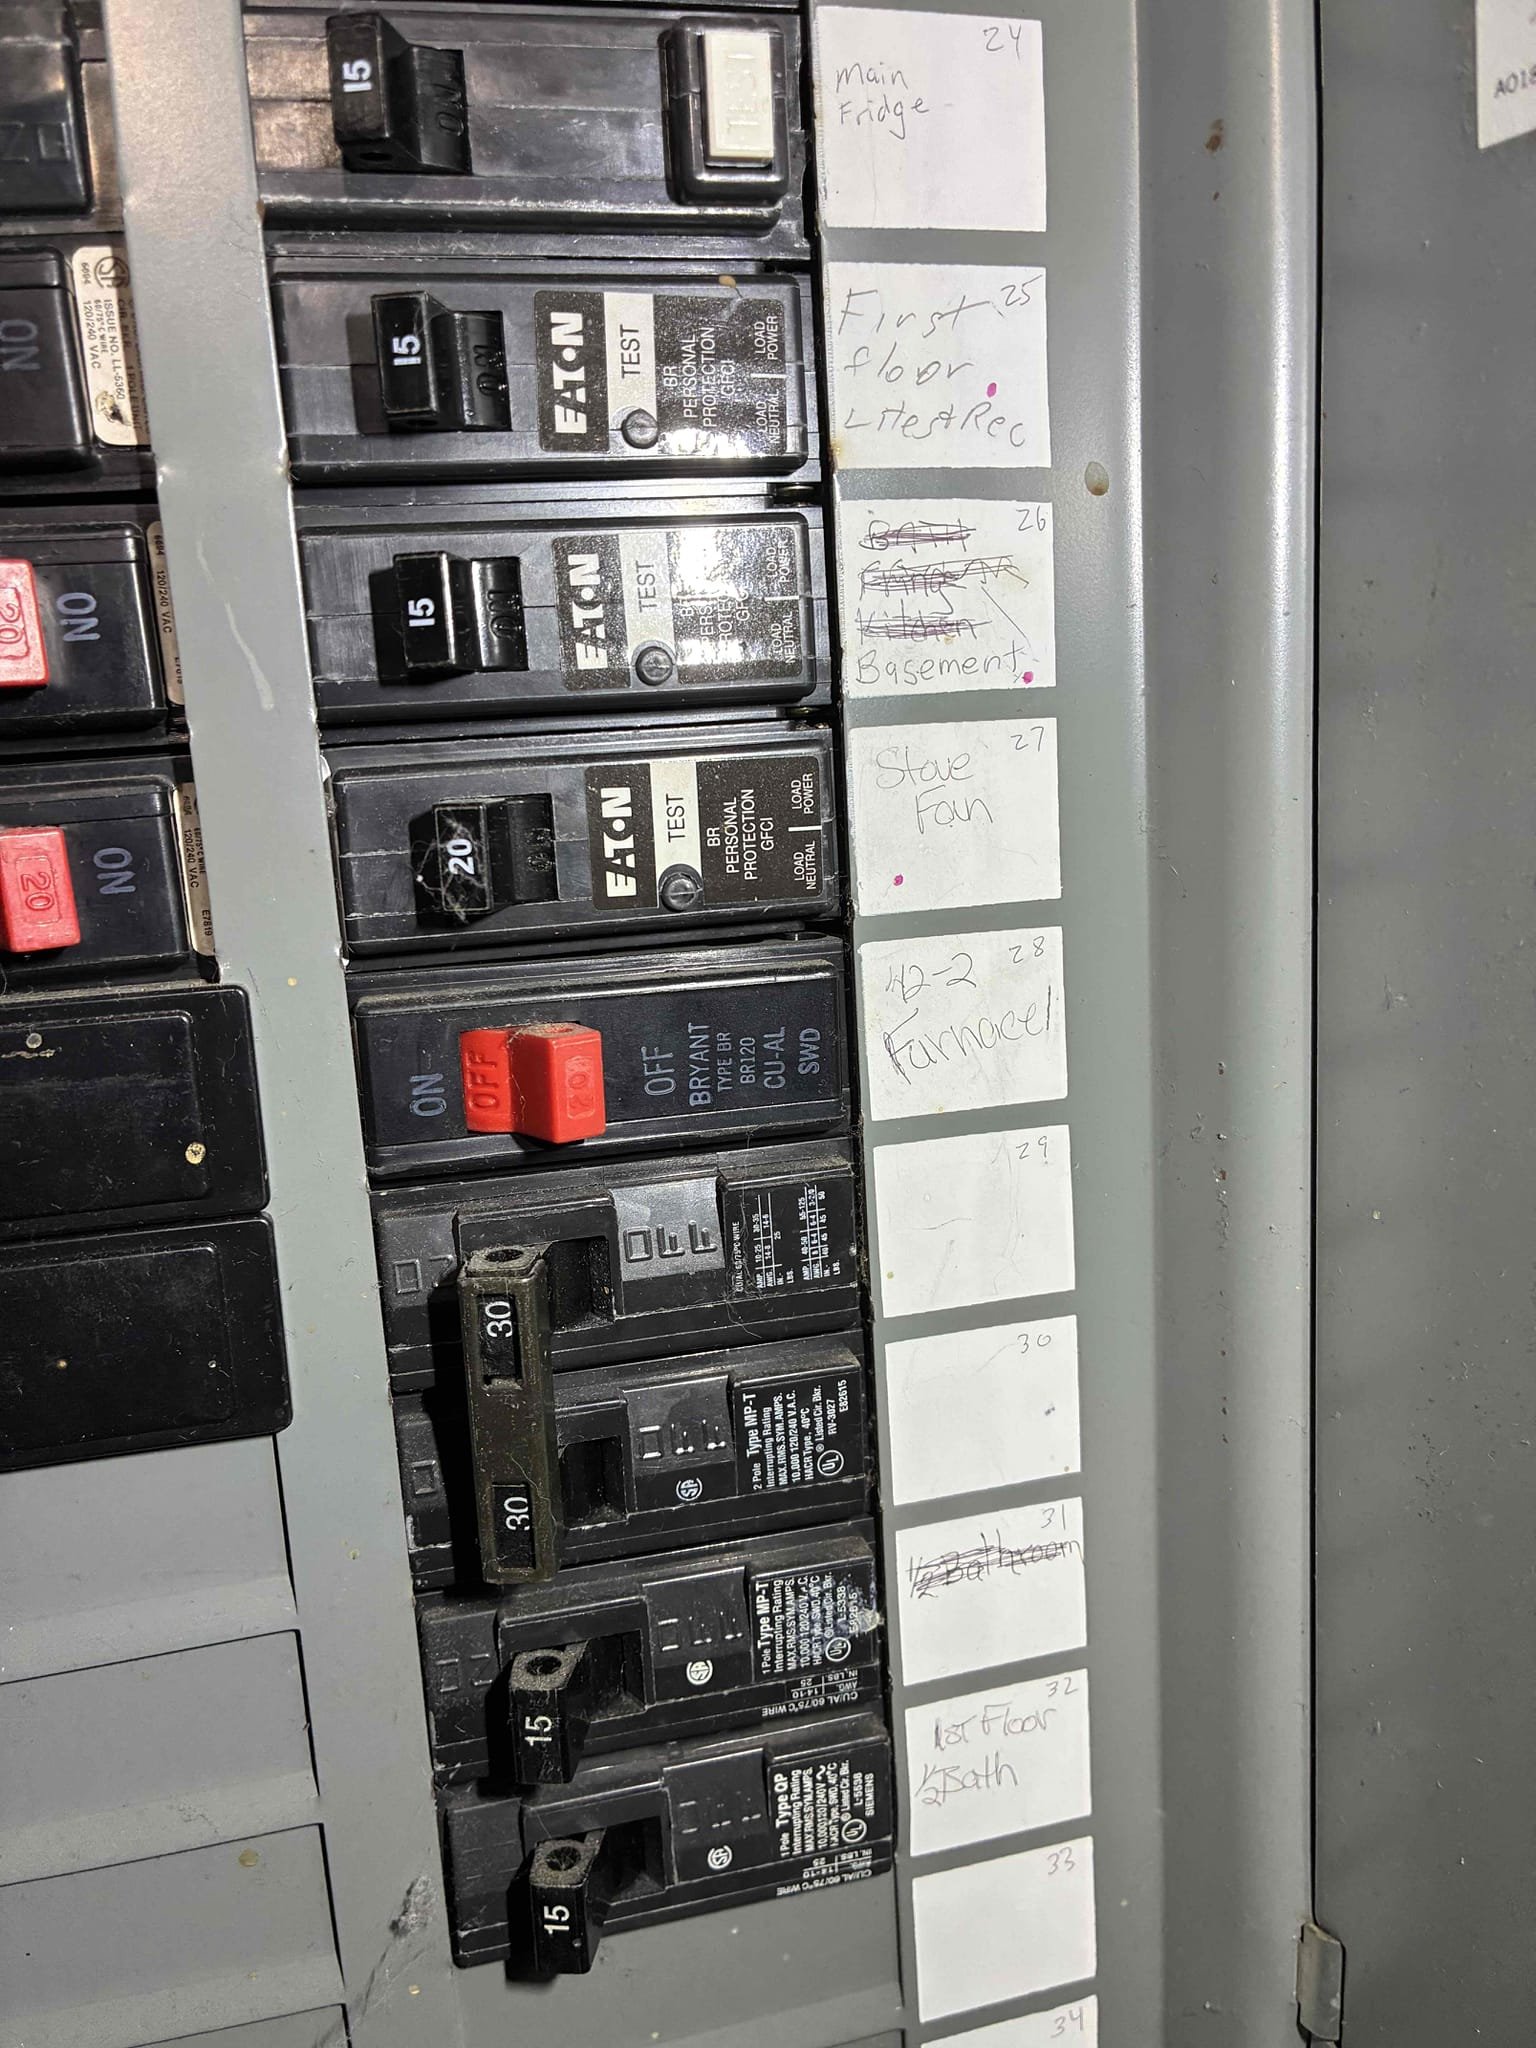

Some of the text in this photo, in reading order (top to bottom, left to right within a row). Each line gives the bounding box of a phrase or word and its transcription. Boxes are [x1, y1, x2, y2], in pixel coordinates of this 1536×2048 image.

[983, 24, 1021, 61] 24
[342, 58, 373, 93] 15
[839, 94, 930, 140] Fridge
[1000, 275, 1043, 306] 25
[104, 299, 115, 333] ISSUE
[0, 320, 40, 370] ON
[83, 300, 101, 369] 120/240 VAC
[109, 336, 119, 356] NO.
[392, 334, 422, 366] 15
[619, 324, 641, 379] TEST
[754, 321, 766, 355] LOAD
[767, 315, 779, 361] POWER
[663, 364, 679, 389] BR
[682, 334, 699, 419] PERSONAL
[701, 327, 718, 428] PROTECTION
[721, 358, 736, 398] GFCI
[755, 401, 767, 433] LOAD
[768, 389, 780, 445] NEUTRAL
[1016, 506, 1046, 532] 26
[765, 547, 777, 579] LOAD
[779, 541, 792, 584] POWER
[156, 570, 172, 633] 120/240 VAC
[636, 560, 657, 612] TEST
[56, 592, 100, 641] ON
[407, 597, 436, 627] 15
[770, 622, 782, 655] LOAD
[782, 612, 796, 665] NEUTRAL
[856, 640, 1026, 685] Basement
[1009, 726, 1045, 753] 27
[876, 746, 975, 789] Stove
[791, 779, 802, 810] LOAD
[803, 773, 814, 815] POWER
[914, 784, 994, 834] Fan
[666, 793, 685, 843] TEST
[724, 797, 740, 874] PERSONAL
[741, 789, 758, 880] PROTECTION
[760, 817, 774, 851] GFCI
[707, 827, 721, 847] BR
[93, 847, 136, 895] ON
[183, 829, 194, 863] 120/240
[189, 867, 199, 888] VAC
[447, 839, 475, 875] 20
[794, 851, 805, 881] LOAD
[806, 840, 817, 890] NEUTRAL
[20, 872, 54, 911] 20
[202, 910, 213, 936] E7819
[1008, 936, 1044, 964] 28
[688, 1022, 711, 1107] BRYANT
[717, 1032, 733, 1092] TYPE BR
[739, 1037, 756, 1085] BR120
[763, 1026, 786, 1089] CU-AL
[798, 1028, 821, 1075] SWD
[465, 1051, 499, 1114] OFF
[641, 1046, 677, 1096] OFF
[409, 1073, 447, 1117] ON
[1016, 1136, 1049, 1161] 29
[819, 1191, 825, 1200] 50
[732, 1221, 740, 1240] WIRE
[774, 1231, 781, 1240] 25
[819, 1214, 827, 1223] 45
[622, 1219, 718, 1263] OFF
[485, 1300, 513, 1338] 30
[1017, 1334, 1051, 1354] 30
[743, 1393, 758, 1427] MP-T
[787, 1390, 797, 1417] V.A.C.
[813, 1385, 824, 1441] Listed Cir. Bkr.
[838, 1379, 849, 1412] E82615
[827, 1399, 838, 1435] RV-3027
[746, 1429, 762, 1458] Type
[762, 1407, 775, 1487] Interrupting Rating
[788, 1418, 799, 1453] 120/240
[801, 1407, 814, 1480] HACR 40°C
[752, 1463, 762, 1482] Pole
[503, 1496, 531, 1531] 30
[1041, 1504, 1066, 1530] 31
[756, 1582, 770, 1615] MP-T
[757, 1617, 773, 1648] Type
[773, 1580, 785, 1672] Interrupting Rating
[762, 1648, 771, 1668] Pole
[800, 1678, 812, 1687] 25
[1046, 1677, 1078, 1697] 32
[761, 1705, 787, 1716] WIRE
[981, 1701, 1056, 1736] Floor
[525, 1715, 553, 1748] 15
[774, 1773, 788, 1792] QP
[865, 1773, 875, 1816] SIEMENS
[775, 1794, 791, 1828] Type
[791, 1770, 802, 1855] Interrupting Rating
[780, 1833, 789, 1851] Pole
[1048, 1847, 1076, 1876] 33
[543, 1904, 571, 1936] 15
[1051, 2006, 1084, 2039] 34
